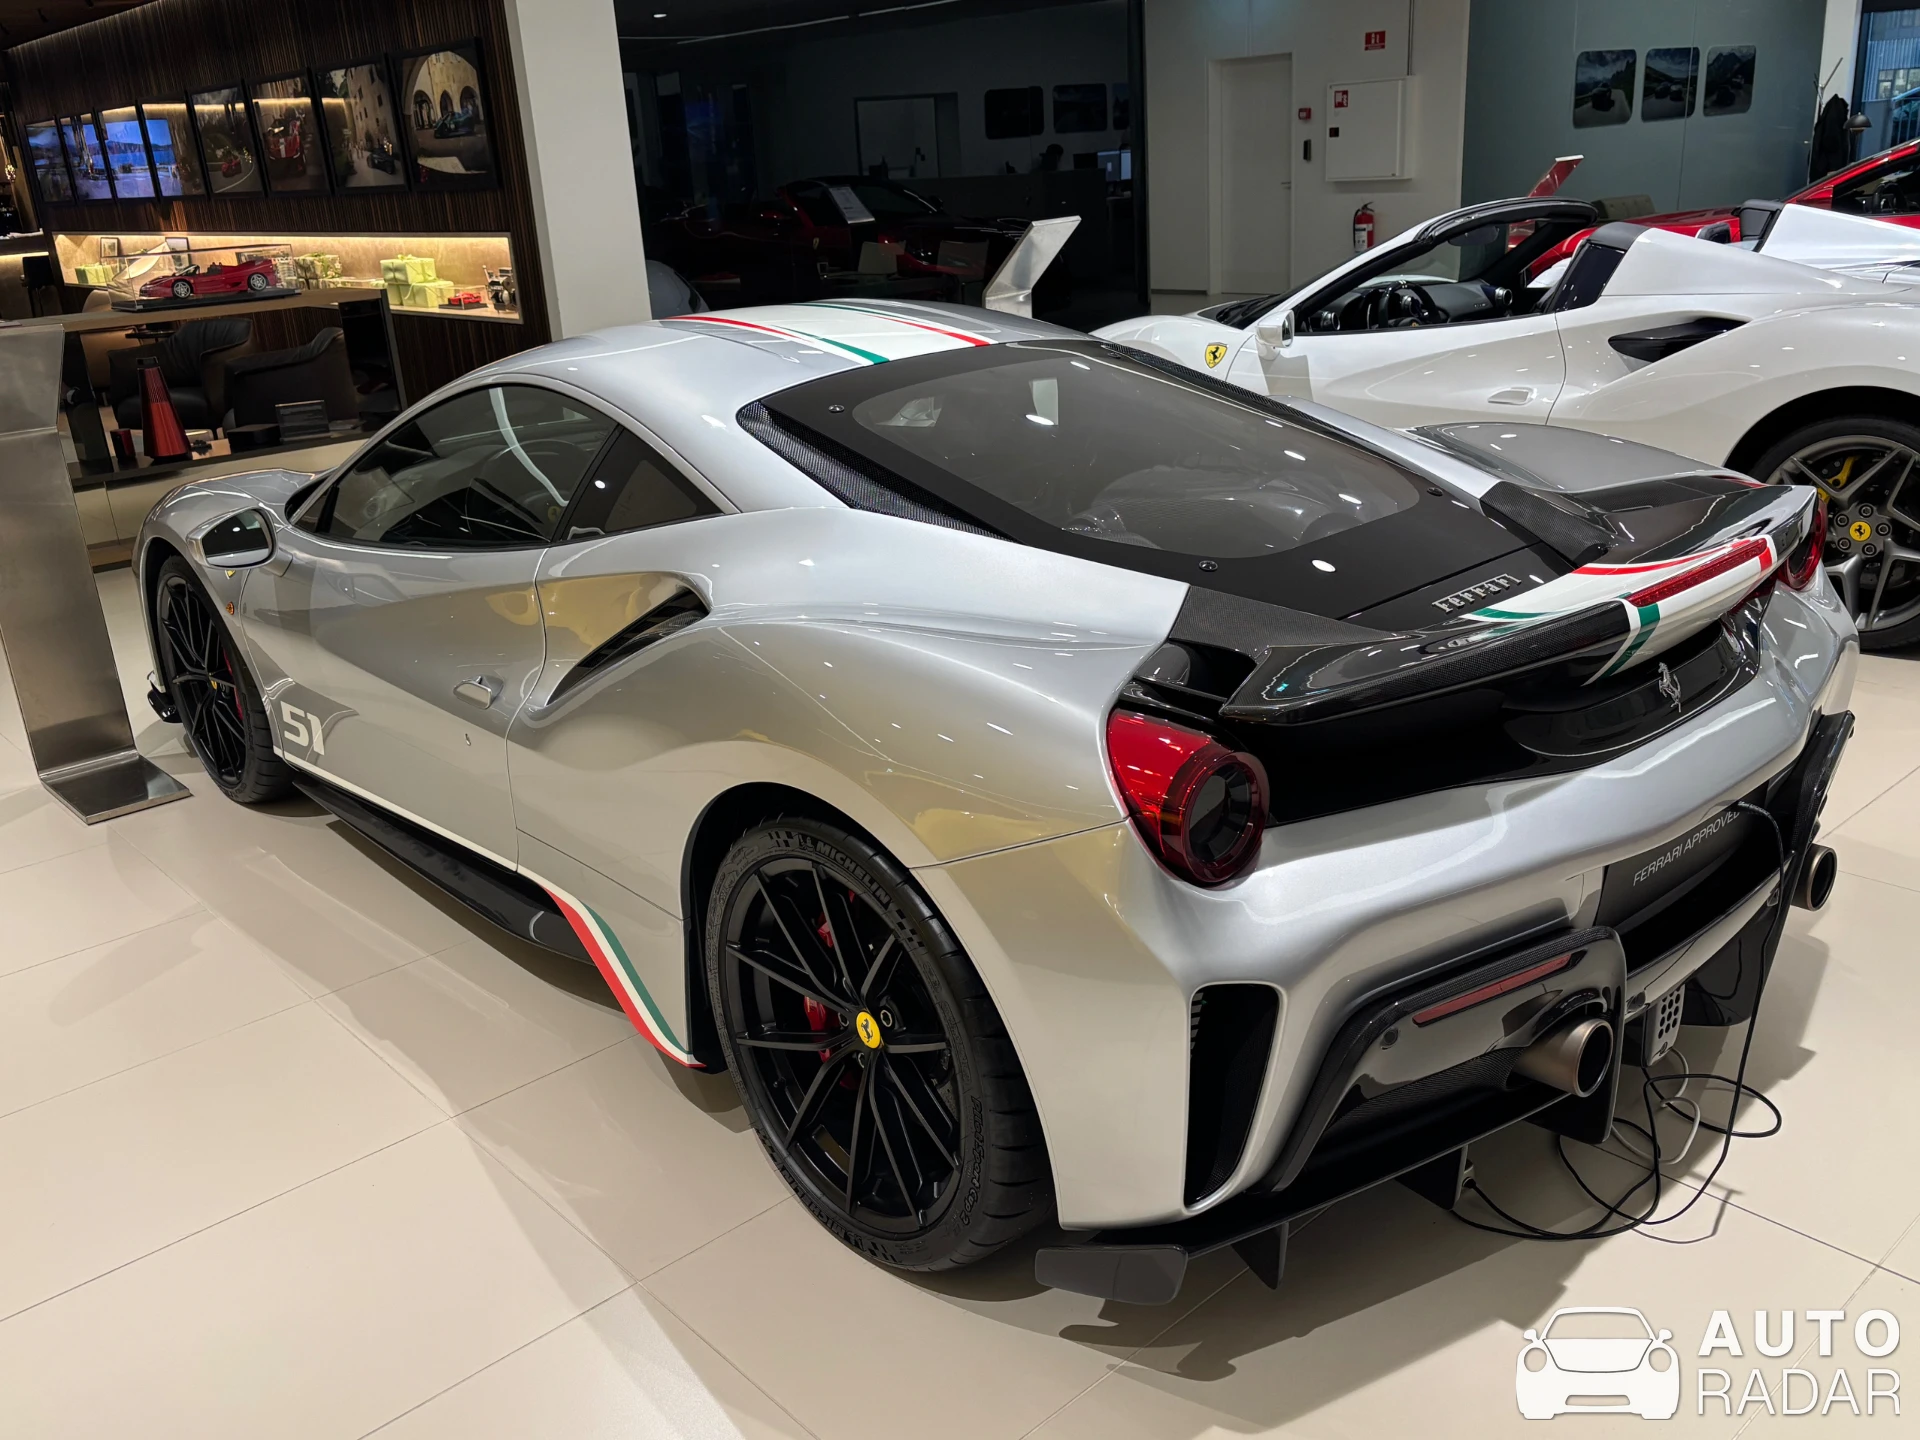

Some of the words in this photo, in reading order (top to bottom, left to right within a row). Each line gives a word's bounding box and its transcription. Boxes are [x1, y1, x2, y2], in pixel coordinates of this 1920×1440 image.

[1432, 573, 1522, 614] Ferrari
[280, 700, 325, 756] 51
[816, 840, 892, 906] MICHELIN
[1633, 843, 1683, 887] FERRARI
[970, 1142, 985, 1190] Sport
[959, 1210, 971, 1226] 2
[964, 1187, 979, 1214] Cup
